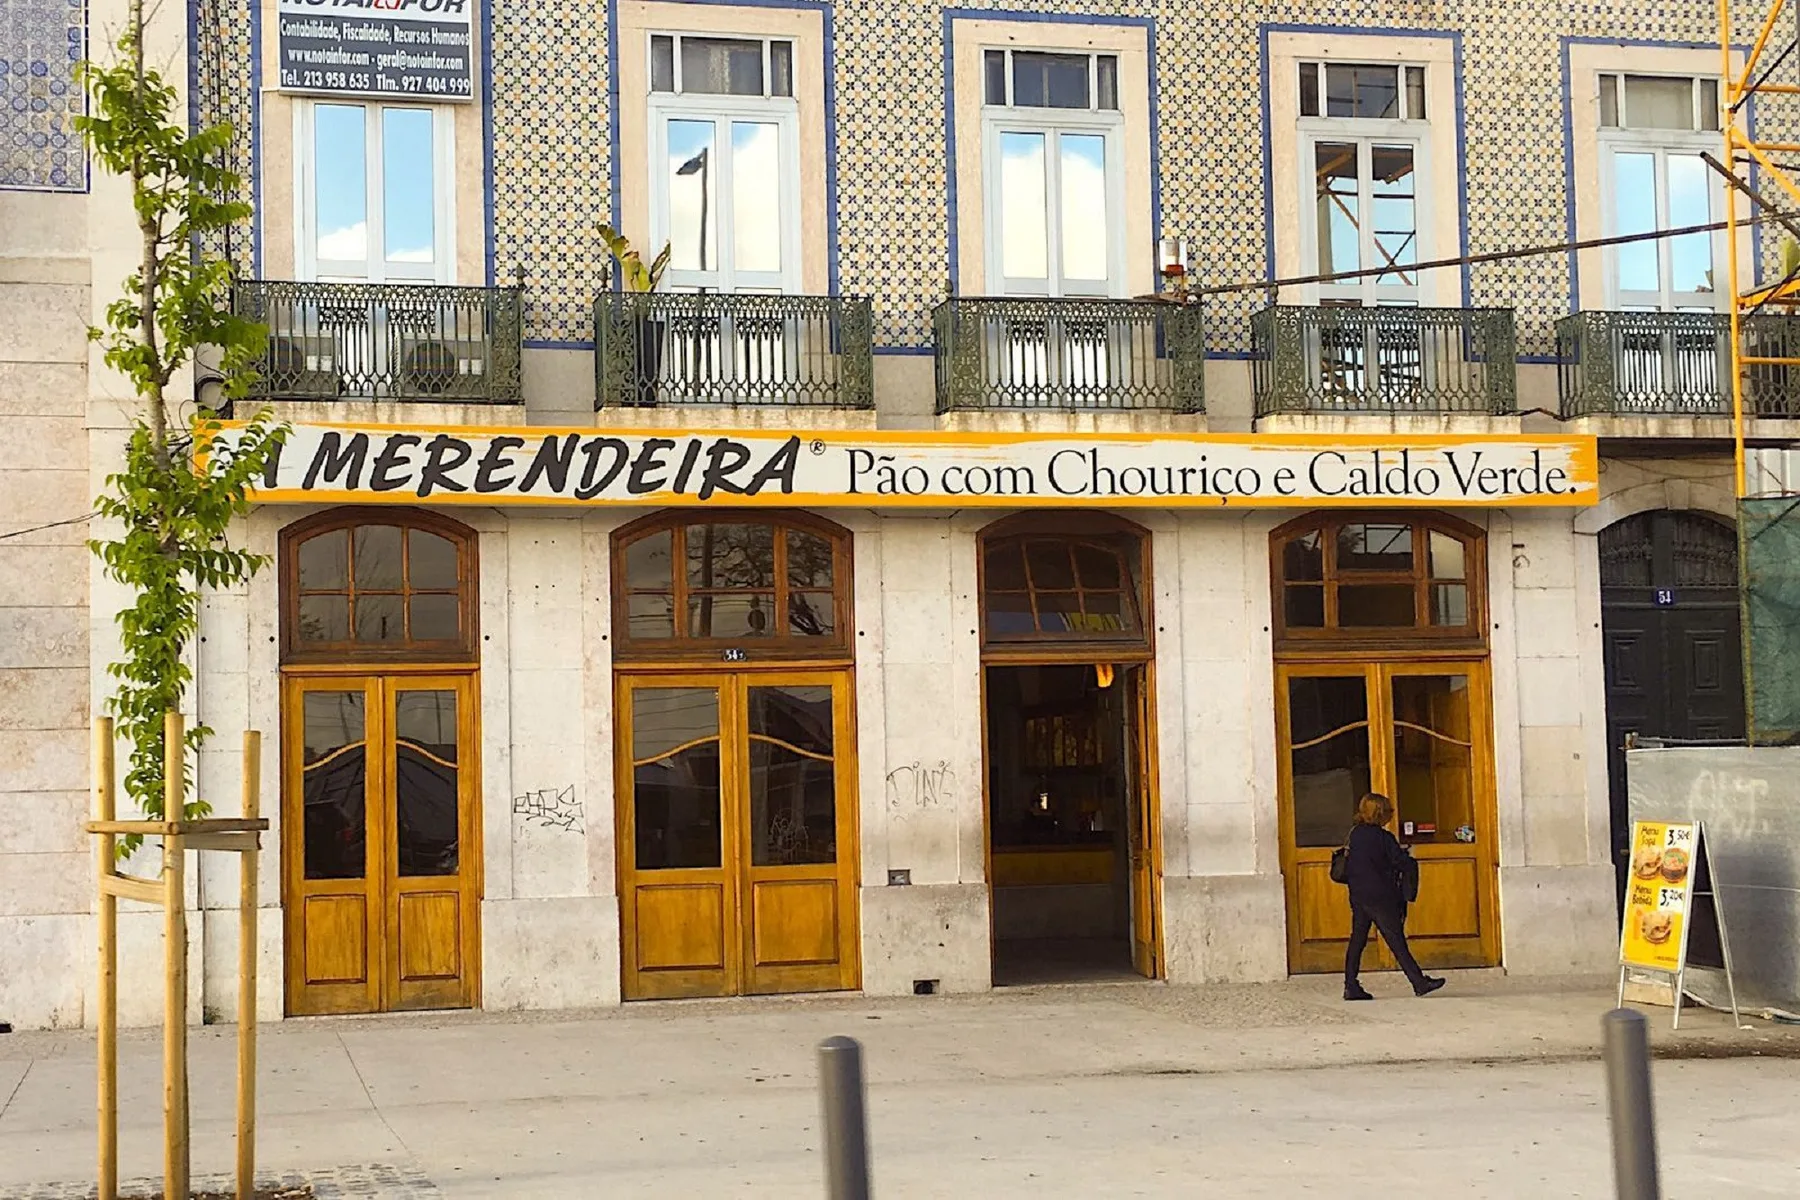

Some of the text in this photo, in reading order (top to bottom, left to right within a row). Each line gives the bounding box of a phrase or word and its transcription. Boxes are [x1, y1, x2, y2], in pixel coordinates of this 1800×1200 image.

[281, 18, 469, 46] Contabilidade, Fiscalidade, Recursos Humanos
[288, 45, 370, 66] www.notainfor.com
[377, 49, 463, 71] geral@notainfor.com
[281, 68, 470, 94] Tel. 213 958 635 Tlm. 927 404 999
[302, 432, 800, 503] MERENDEIRA
[846, 448, 1577, 505] Pão com Chouriço e Caldo Verde.
